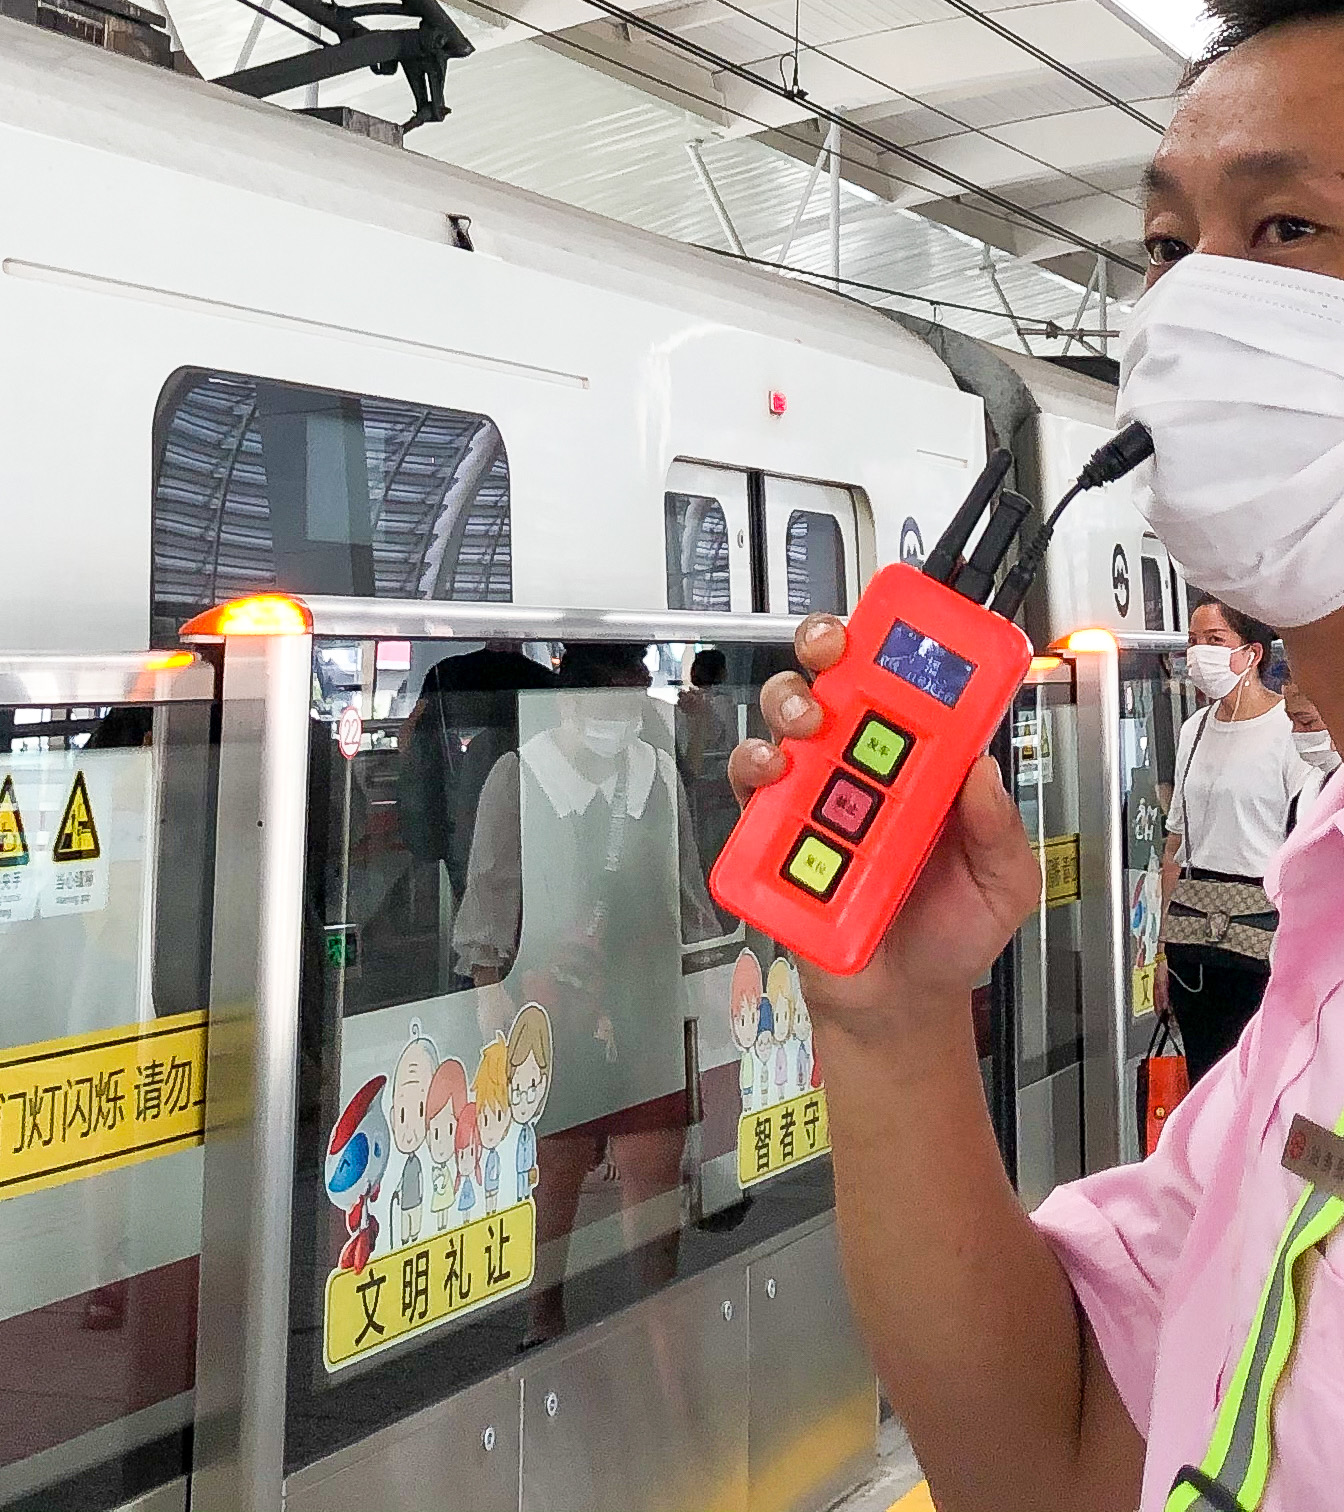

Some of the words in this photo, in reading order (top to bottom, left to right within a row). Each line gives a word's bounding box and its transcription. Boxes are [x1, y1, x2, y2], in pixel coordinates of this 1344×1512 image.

[133, 1055, 206, 1122] 请勿
[755, 1096, 820, 1173] 智者守
[354, 1217, 511, 1347] 文明礼让
